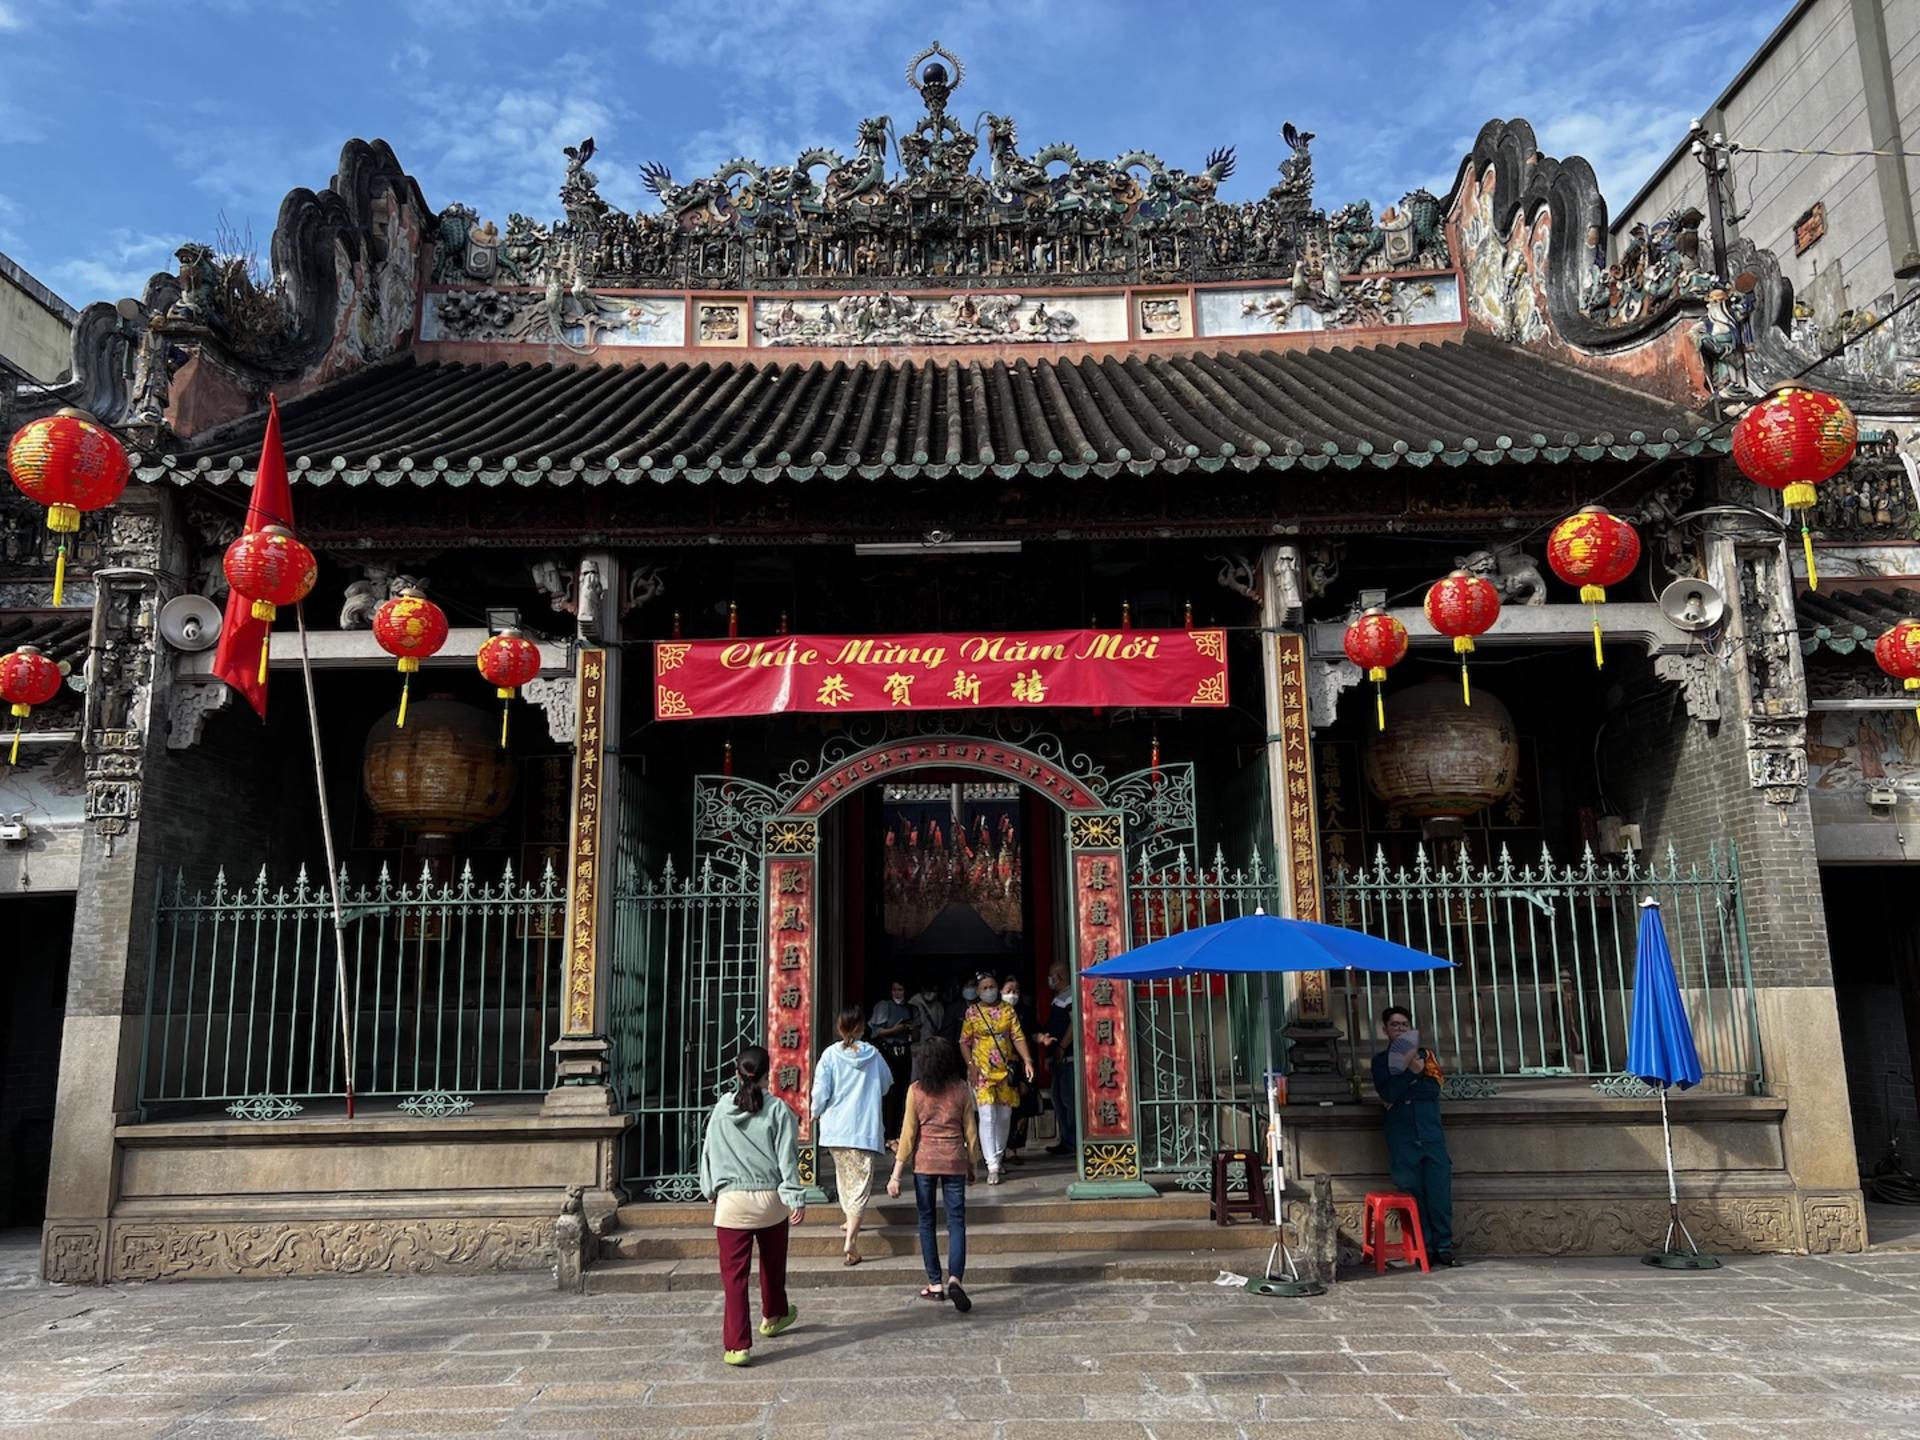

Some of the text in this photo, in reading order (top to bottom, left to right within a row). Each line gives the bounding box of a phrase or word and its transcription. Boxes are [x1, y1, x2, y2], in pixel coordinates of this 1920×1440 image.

[826, 639, 949, 669] Mừng
[959, 636, 1069, 663] Năm
[1075, 633, 1160, 661] Mới
[815, 668, 1049, 707] 恭賀新禧
[1280, 648, 1324, 1012] 和風送暖大地轉新機年豐物家樂
